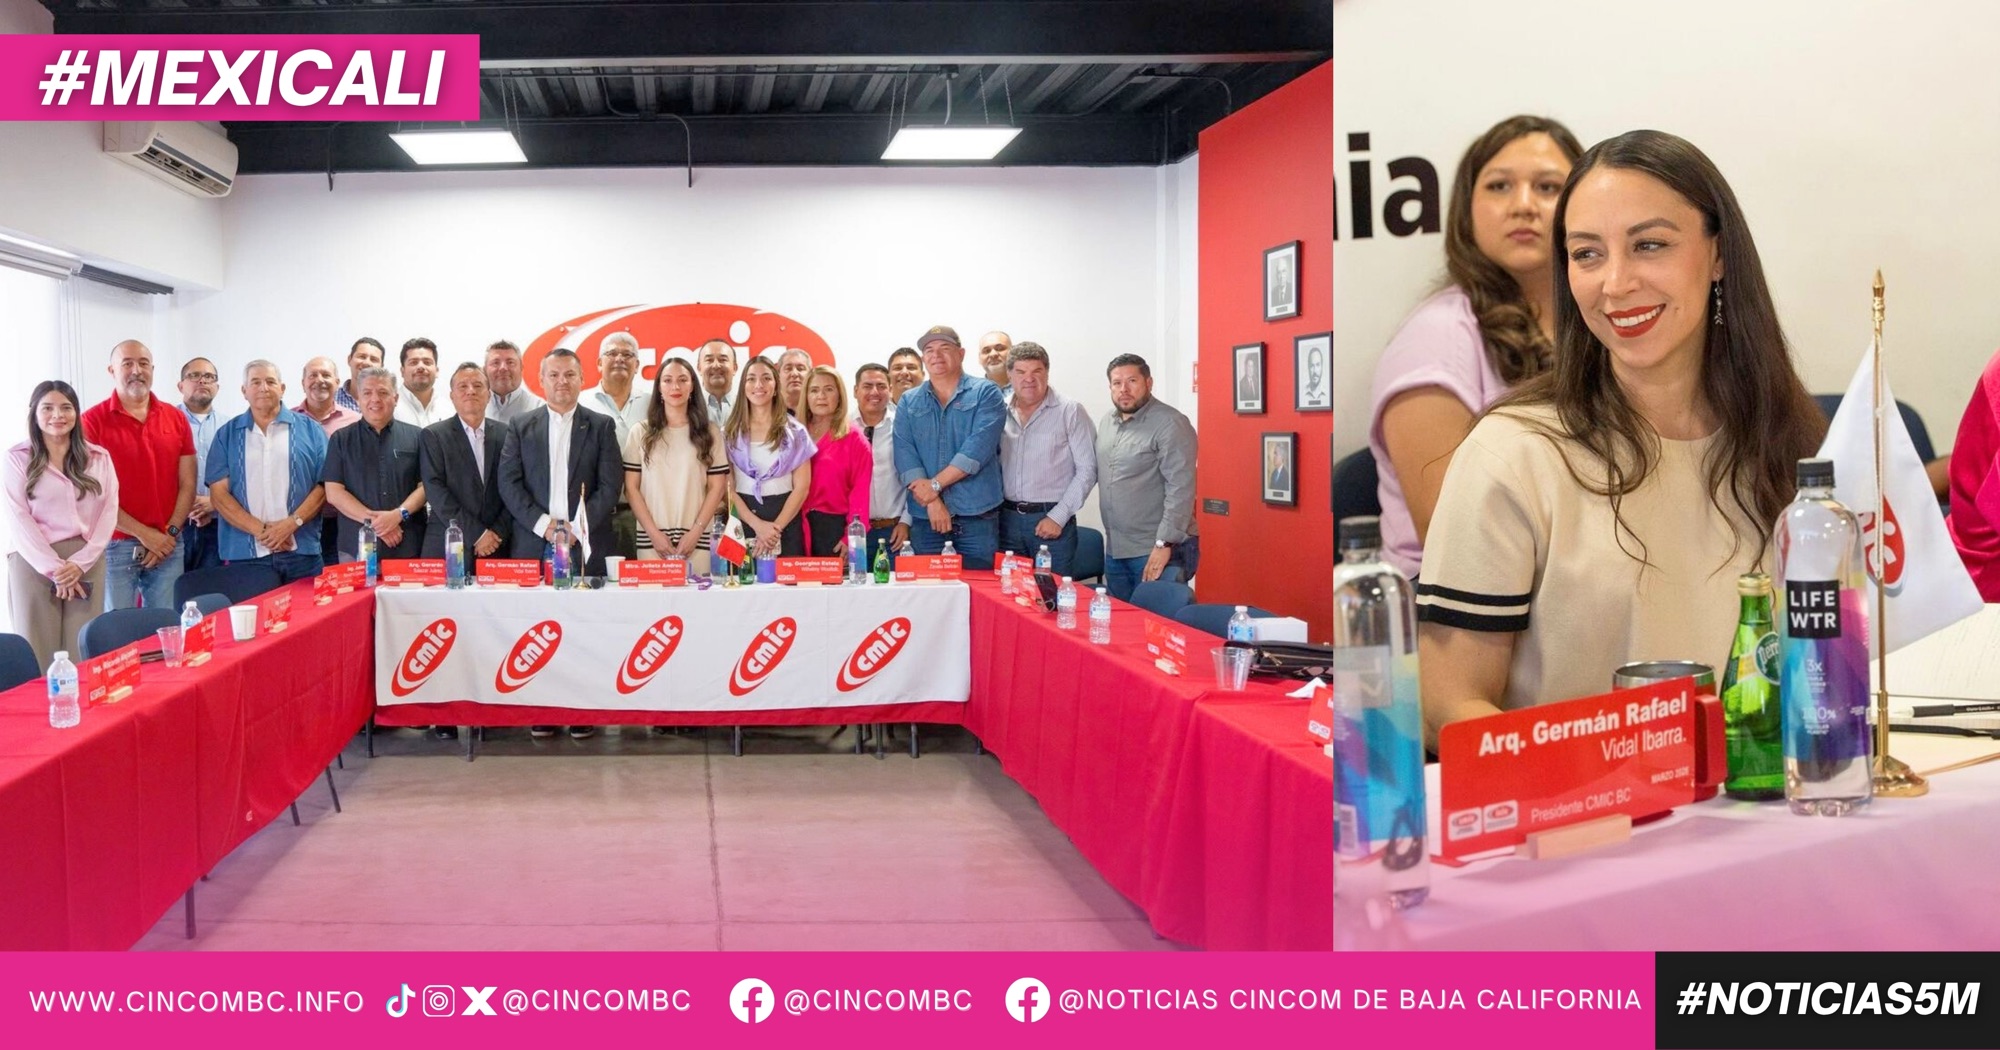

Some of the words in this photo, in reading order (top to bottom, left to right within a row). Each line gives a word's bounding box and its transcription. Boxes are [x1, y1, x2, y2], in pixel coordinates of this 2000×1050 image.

[1333, 131, 1441, 241] ia
[1790, 590, 1836, 608] LIFE
[1790, 612, 1837, 630] WTR
[408, 622, 453, 675] cmic
[513, 623, 559, 673] cmic
[634, 620, 679, 673] cmic
[746, 620, 793, 675] cmic
[857, 621, 907, 672] cmic
[1478, 732, 1526, 757] Arq.
[1533, 709, 1620, 745] Germán
[1626, 691, 1687, 726] Rafael
[1601, 734, 1638, 761] Vidal
[1642, 726, 1687, 751] Ibarra.
[1531, 802, 1583, 824] Presidente
[1585, 791, 1614, 811] CMIC
[1616, 787, 1631, 803] BC
